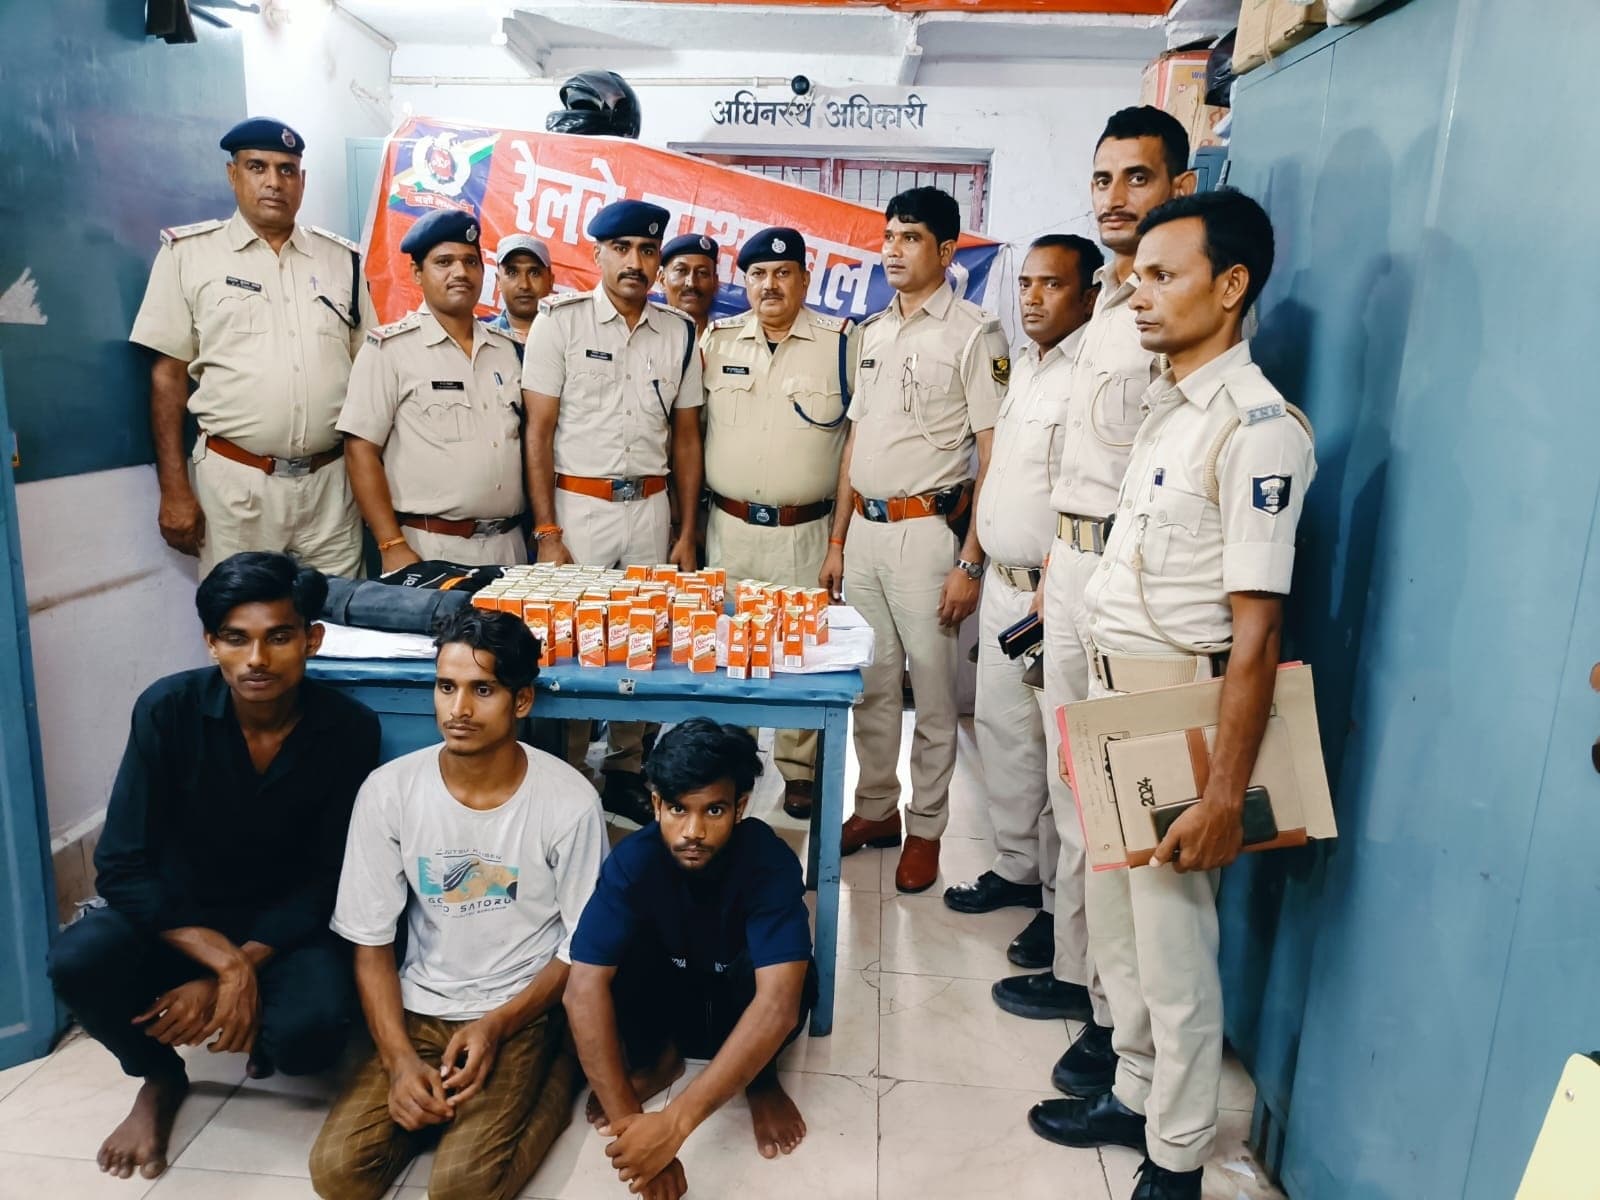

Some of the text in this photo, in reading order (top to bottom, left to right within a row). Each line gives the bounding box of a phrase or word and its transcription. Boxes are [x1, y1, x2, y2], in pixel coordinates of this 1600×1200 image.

[824, 94, 927, 130] अधिकारी
[1137, 777, 1155, 807] 2024
[460, 898, 512, 913] SATORU
